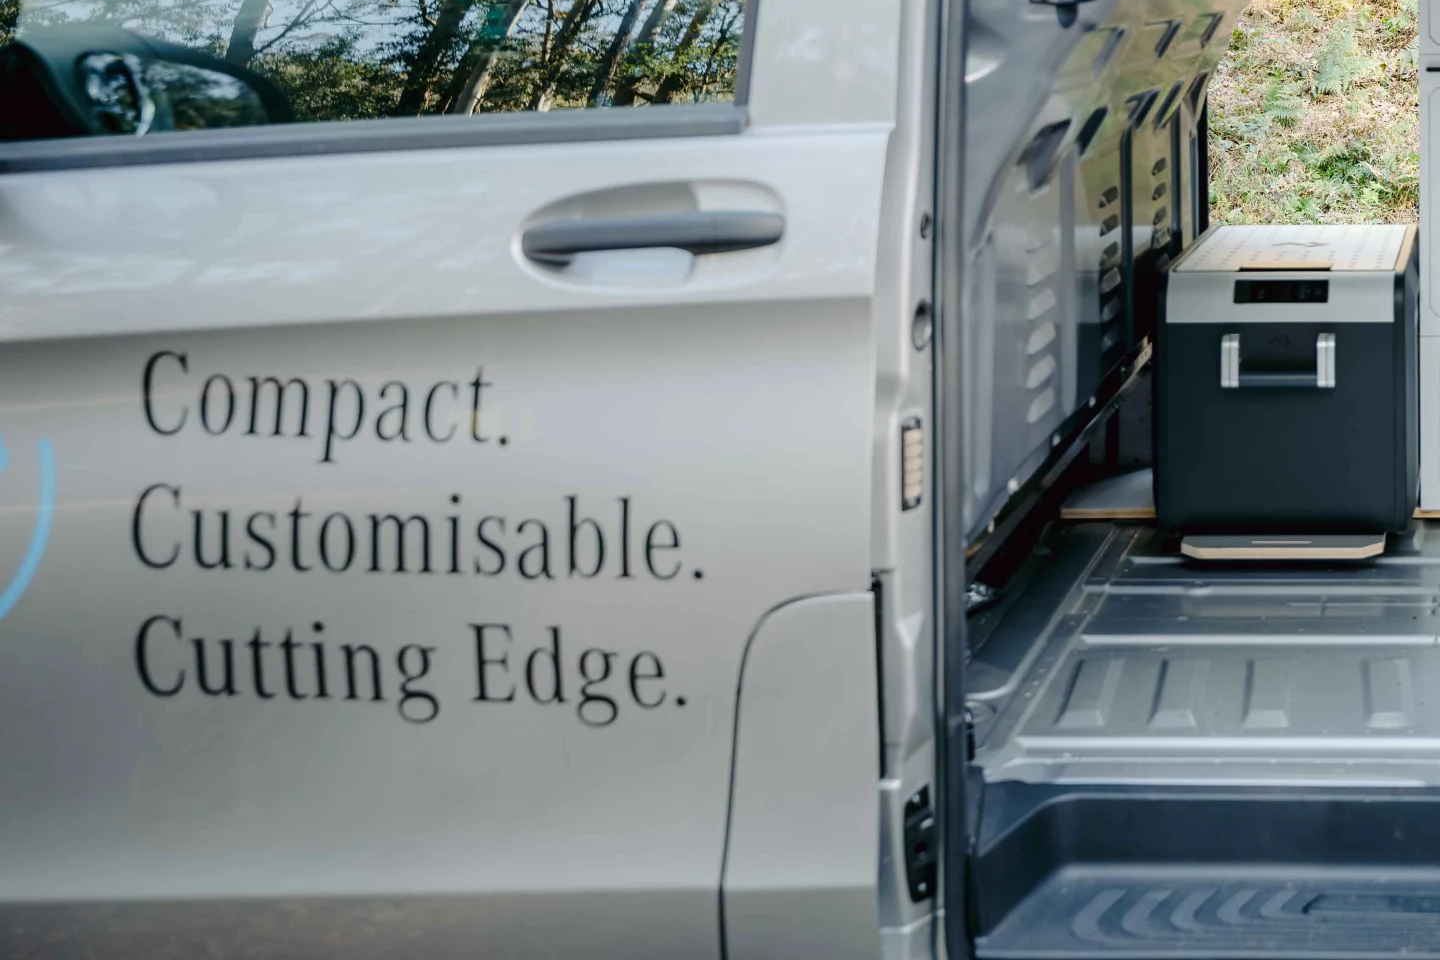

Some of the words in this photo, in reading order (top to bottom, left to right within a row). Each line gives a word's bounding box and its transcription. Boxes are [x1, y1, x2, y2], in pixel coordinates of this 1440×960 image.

[141, 349, 509, 464] Compact.
[130, 482, 706, 582] Customisable.
[133, 614, 441, 725] Cutting
[468, 622, 689, 729] Edge.
